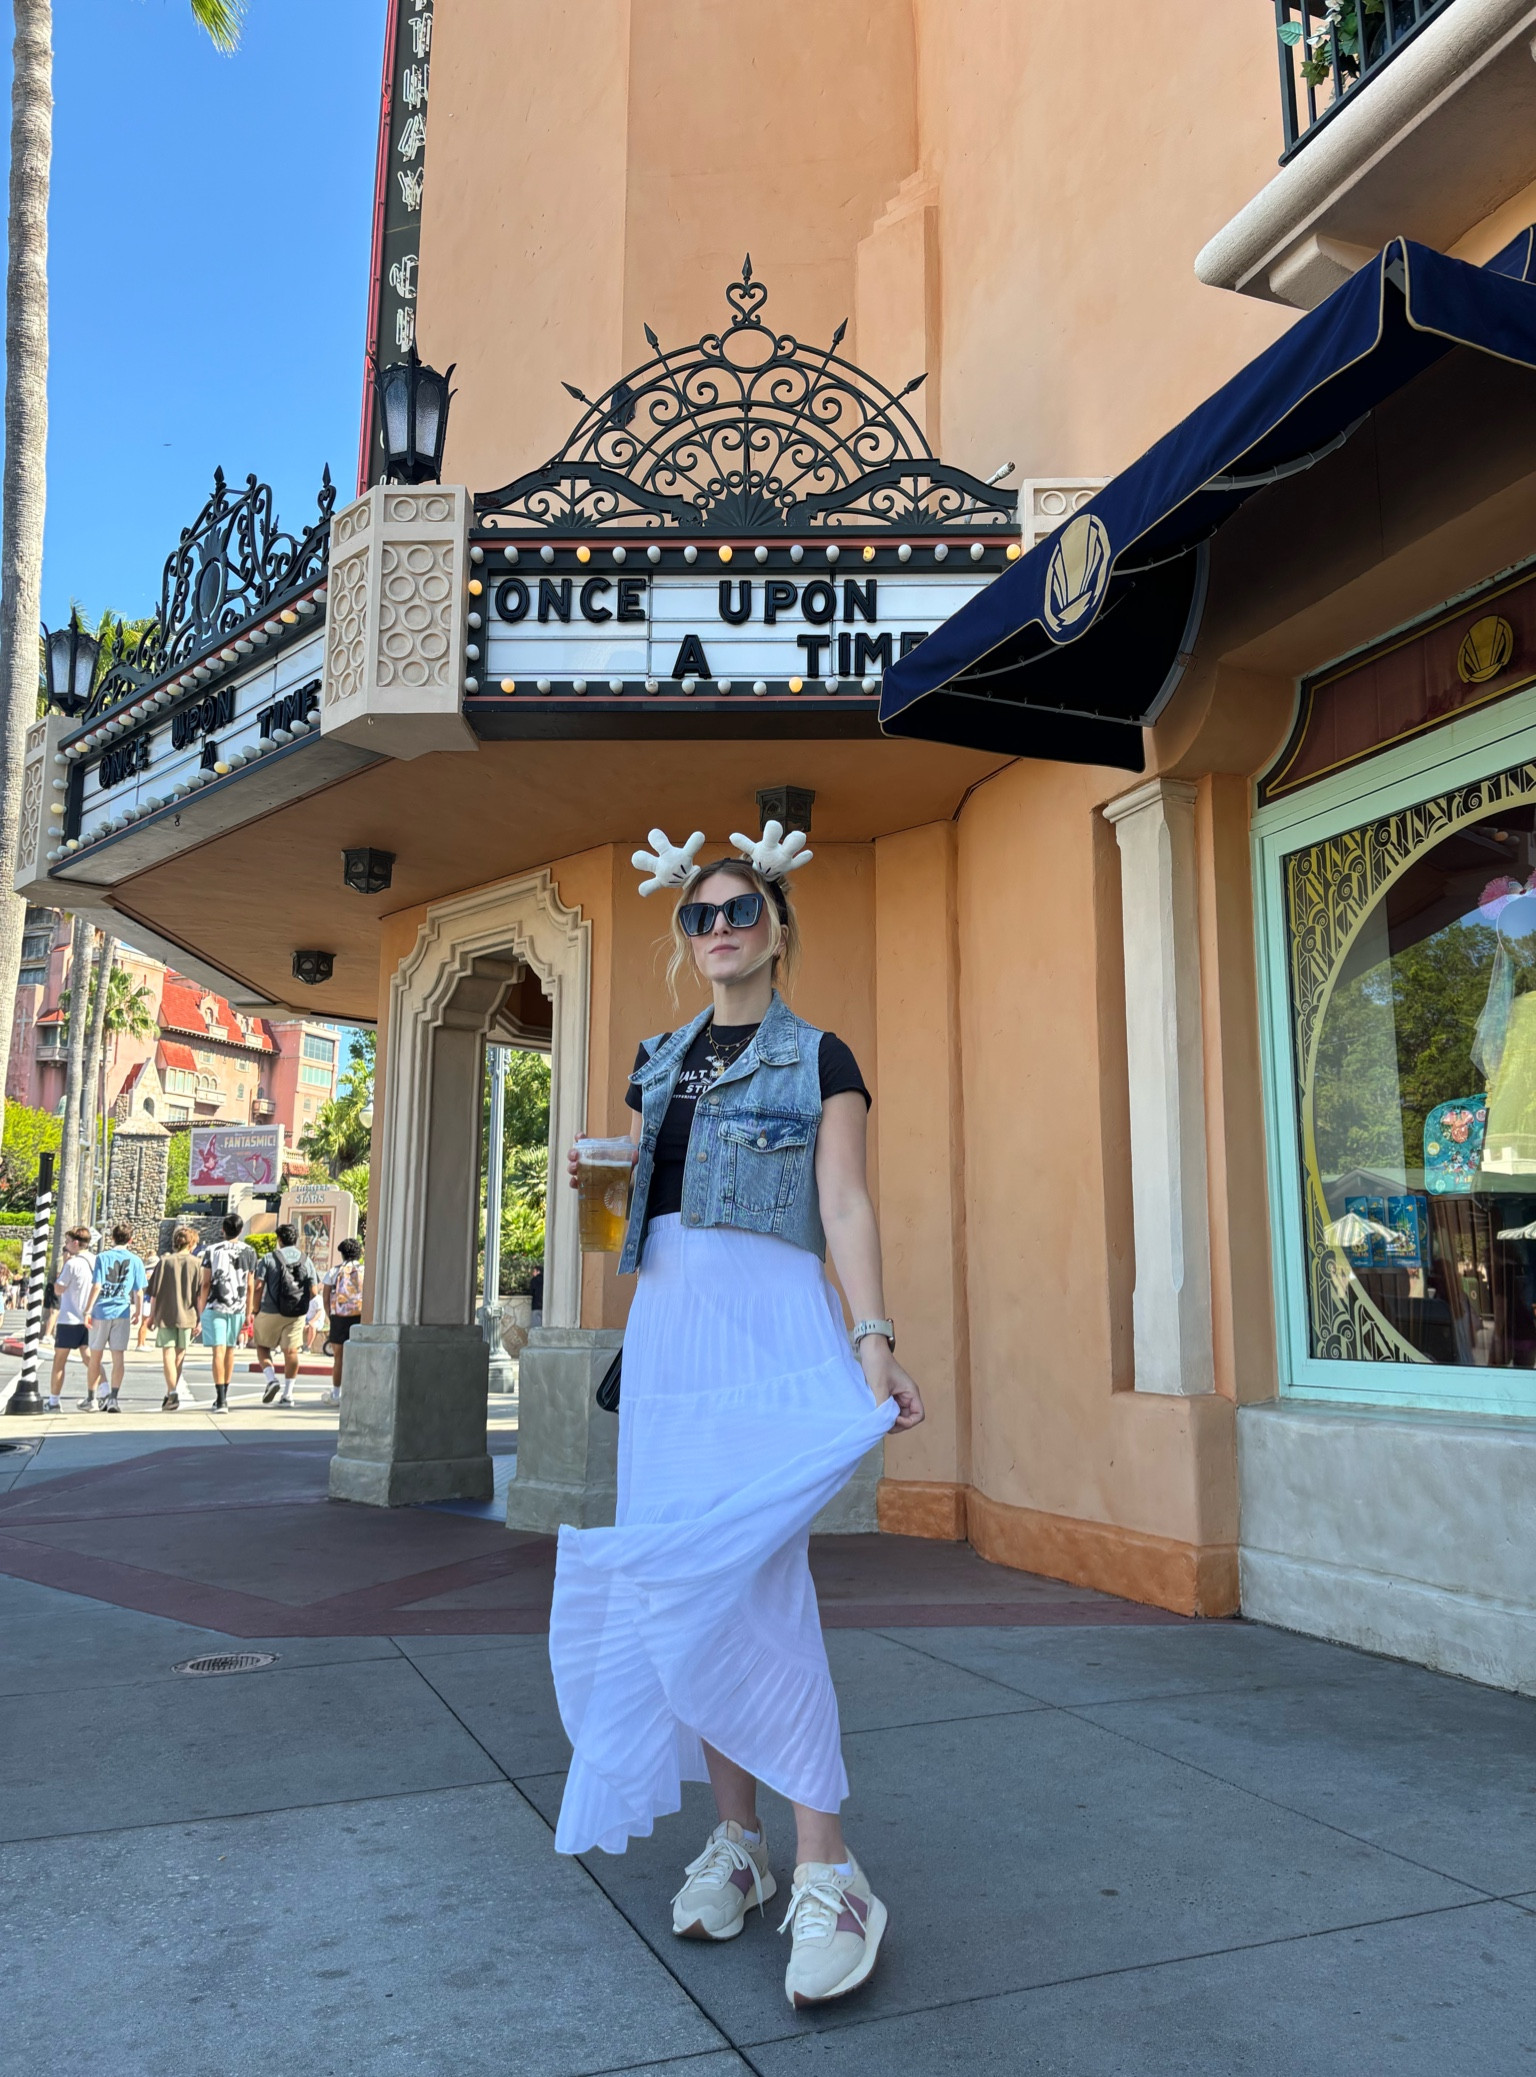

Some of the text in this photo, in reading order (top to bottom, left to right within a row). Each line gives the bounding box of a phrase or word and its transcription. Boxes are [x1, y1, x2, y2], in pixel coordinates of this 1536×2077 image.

[494, 577, 878, 625] ONCE UPON
[671, 634, 712, 680] A
[99, 685, 236, 789] ONCE UPON
[200, 678, 322, 772] A TIME
[224, 1135, 276, 1149] FANTASMIC!
[295, 1193, 325, 1204] STARS
